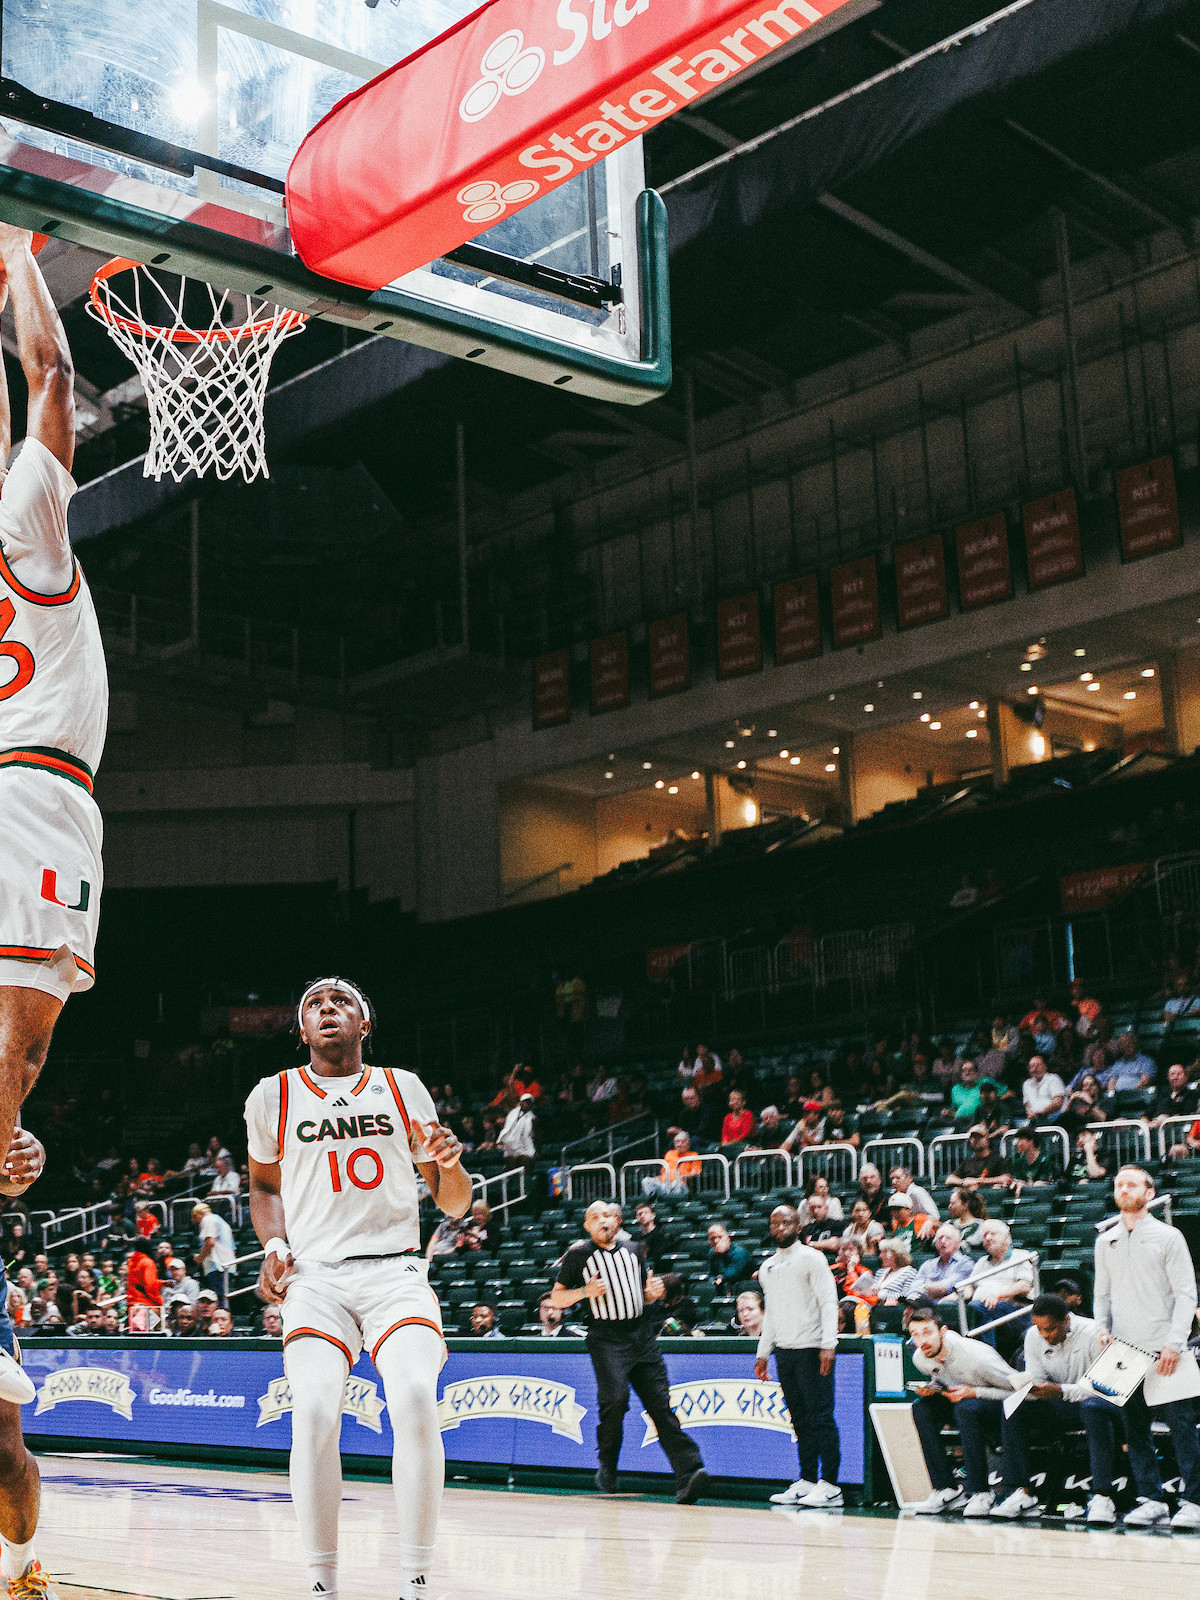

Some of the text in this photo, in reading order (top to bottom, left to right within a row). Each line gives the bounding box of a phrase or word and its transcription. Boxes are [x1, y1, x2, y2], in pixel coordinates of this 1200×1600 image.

[296, 1114, 395, 1143] CANES
[328, 1147, 384, 1192] 10
[50, 1373, 125, 1401] GOOD GREEK
[149, 1388, 245, 1408] GoodGreek.com
[451, 1383, 568, 1419] GOOD GREEK
[737, 1388, 788, 1422] GREE
